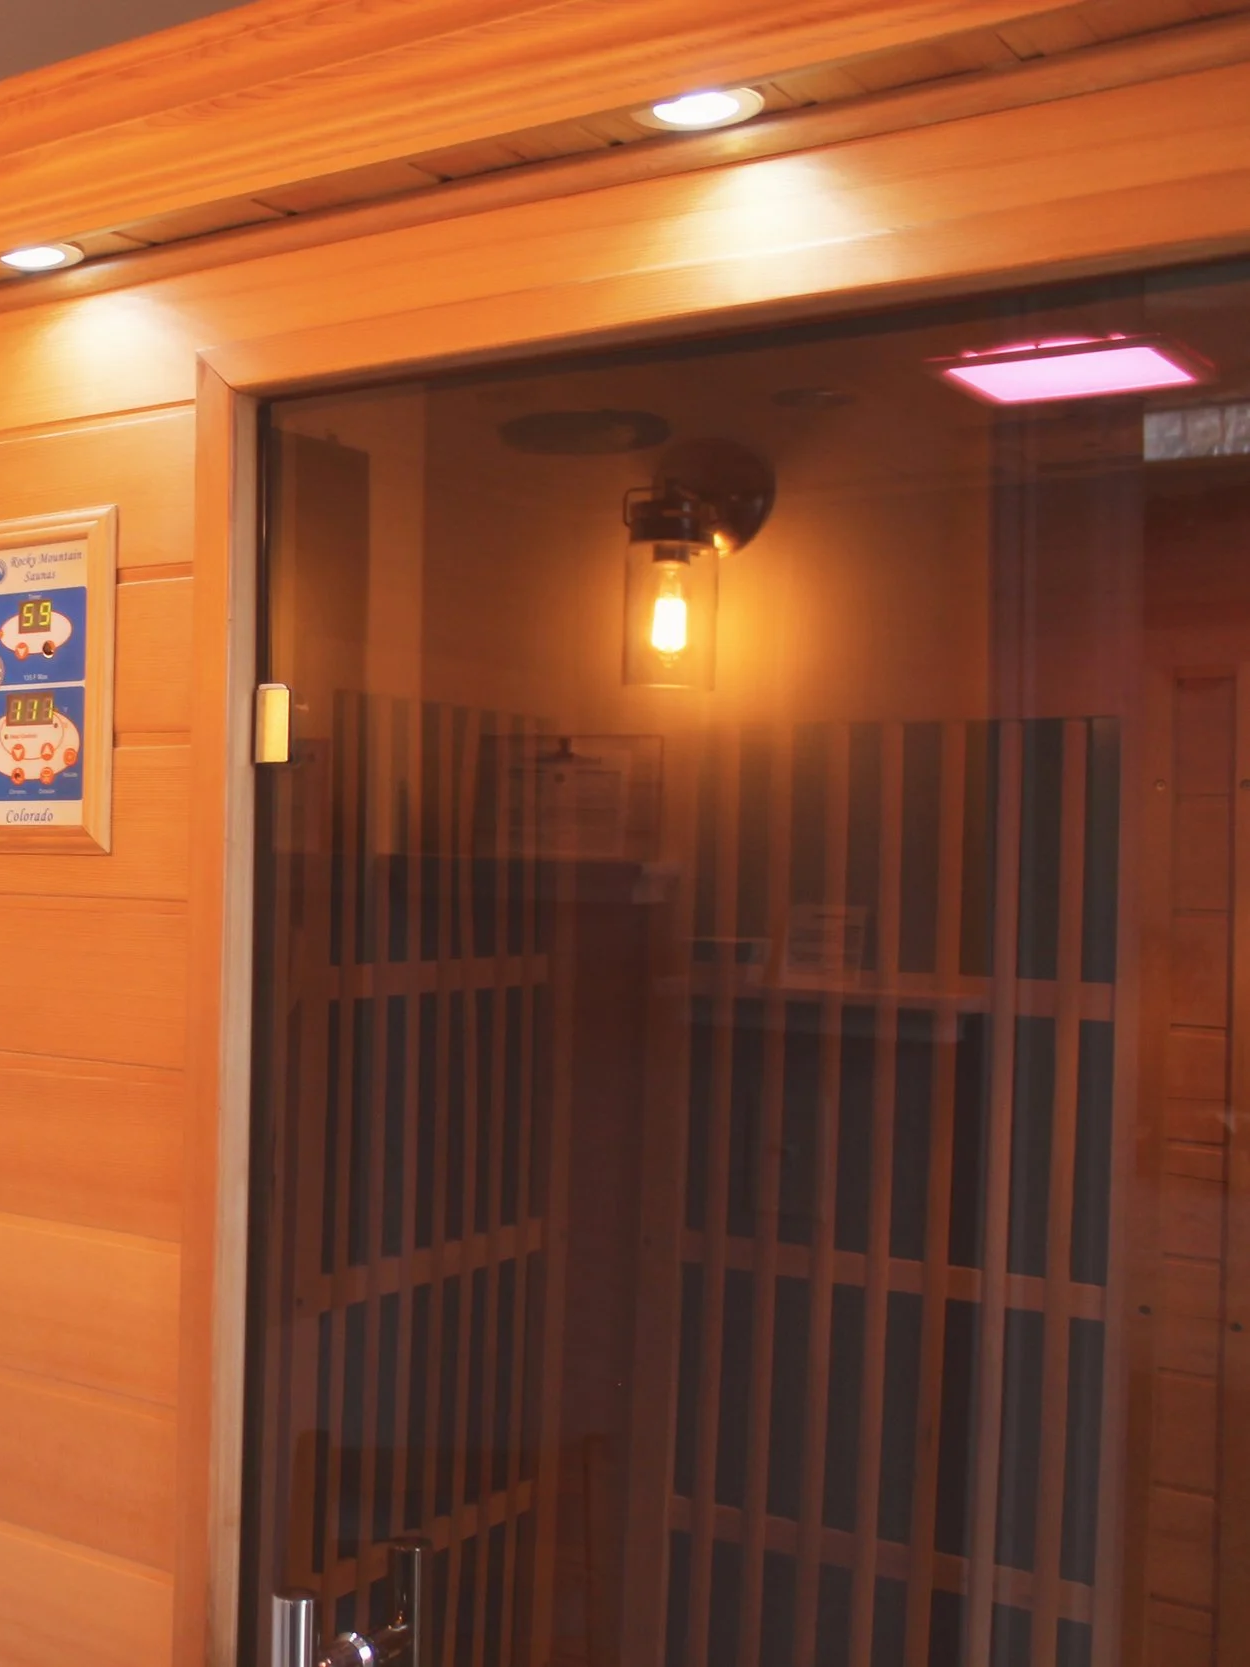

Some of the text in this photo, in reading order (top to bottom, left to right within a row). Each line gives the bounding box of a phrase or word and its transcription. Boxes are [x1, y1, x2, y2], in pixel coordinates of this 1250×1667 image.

[11, 551, 82, 568] Rocky Mountain
[24, 571, 56, 582] Saunas
[22, 601, 52, 627] 59
[15, 699, 54, 721] 111
[6, 807, 53, 823] Colorado
